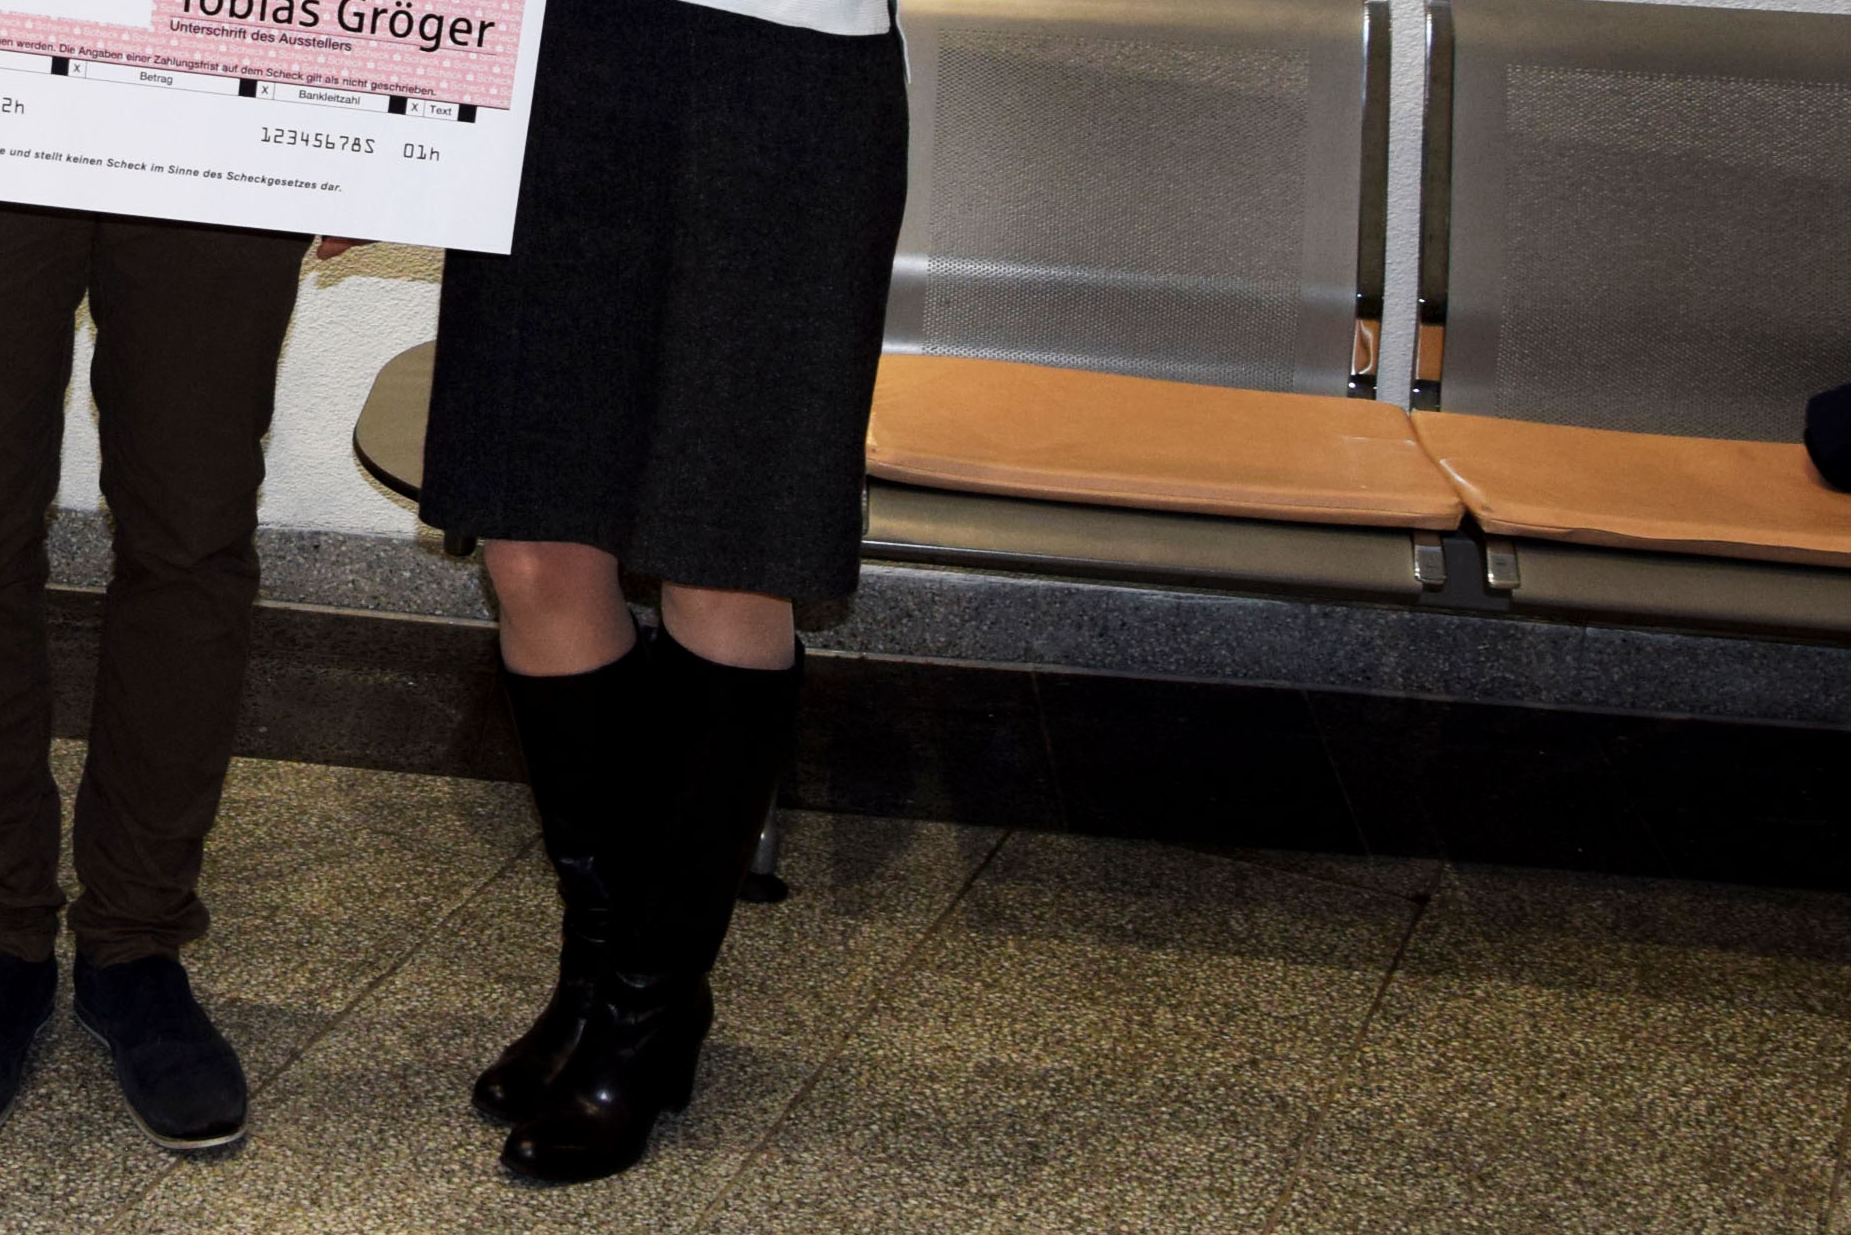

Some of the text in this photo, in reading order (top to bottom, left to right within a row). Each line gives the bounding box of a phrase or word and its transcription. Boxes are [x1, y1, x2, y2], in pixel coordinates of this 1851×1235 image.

[169, 19, 353, 52] Unterschrift des Ausstellers
[16, 39, 56, 52] werden.
[59, 44, 75, 54] Die
[78, 47, 123, 61] Angaben
[126, 53, 150, 63] einer
[153, 55, 219, 71] Zahlungsfrist
[221, 63, 239, 73] auf
[240, 67, 263, 76] dem
[266, 68, 303, 81] Scheck
[306, 72, 323, 84] gilt
[325, 76, 339, 85] als
[342, 77, 368, 88] nicht
[370, 81, 437, 97] geschrieben.
[140, 71, 174, 86] Betrag
[299, 90, 361, 106] Bankleitzahl
[430, 105, 452, 116] Text
[9, 149, 32, 158] und
[33, 151, 64, 162] stellt
[65, 153, 103, 166] keinen
[106, 157, 147, 171] Scheck
[150, 163, 165, 173] im
[167, 164, 200, 177] Sinne
[202, 168, 223, 180] des
[226, 171, 318, 190] Scheckgesetzes
[320, 181, 342, 193] dar.
